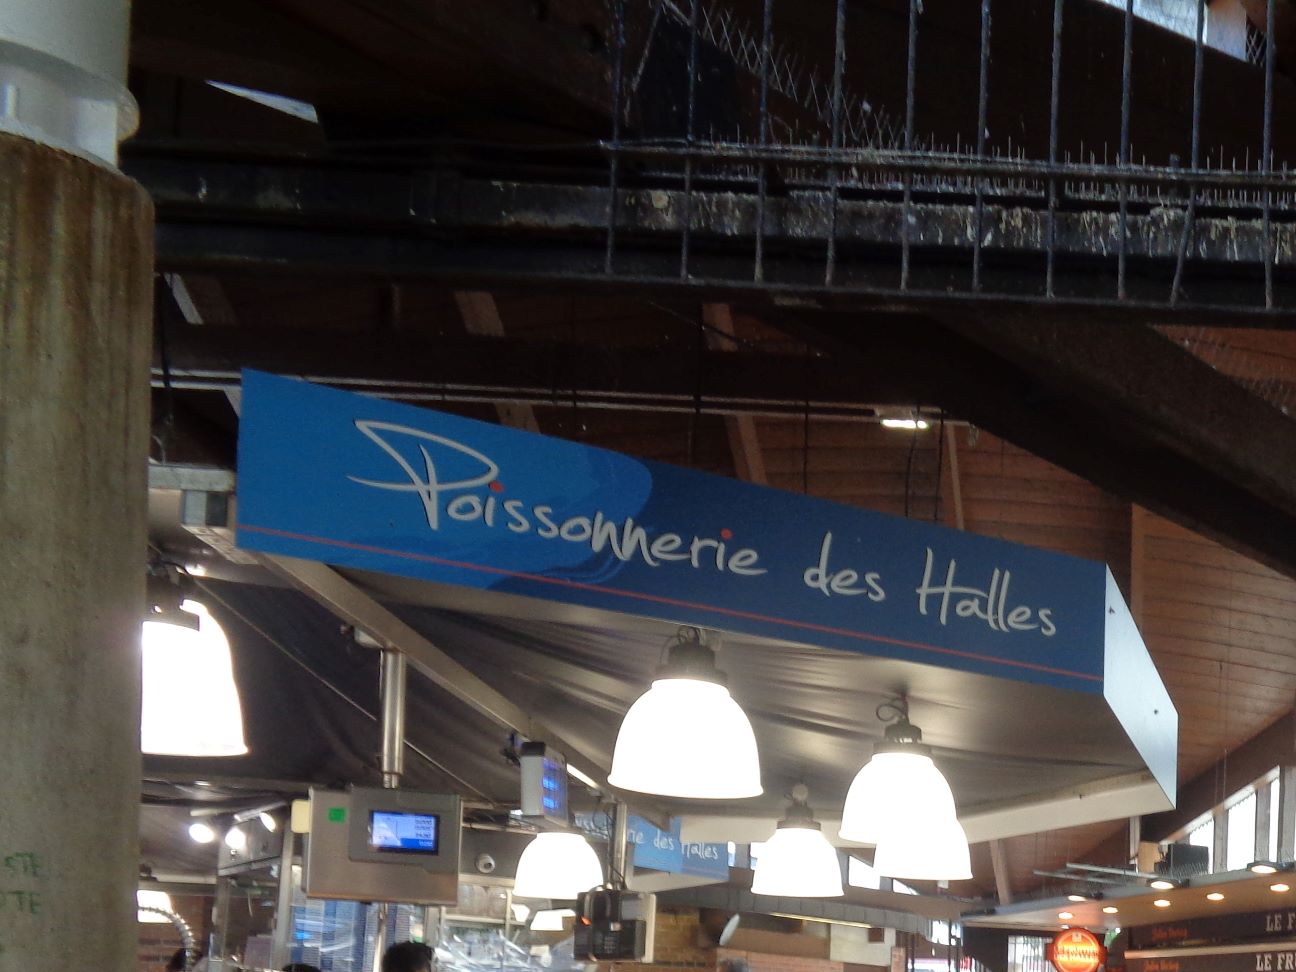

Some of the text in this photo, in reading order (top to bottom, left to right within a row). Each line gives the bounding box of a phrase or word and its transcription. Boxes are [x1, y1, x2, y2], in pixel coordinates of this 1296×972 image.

[347, 420, 1057, 636] Poissonnerie des Halles
[1266, 913, 1282, 932] LE
[1255, 953, 1272, 971] LE
